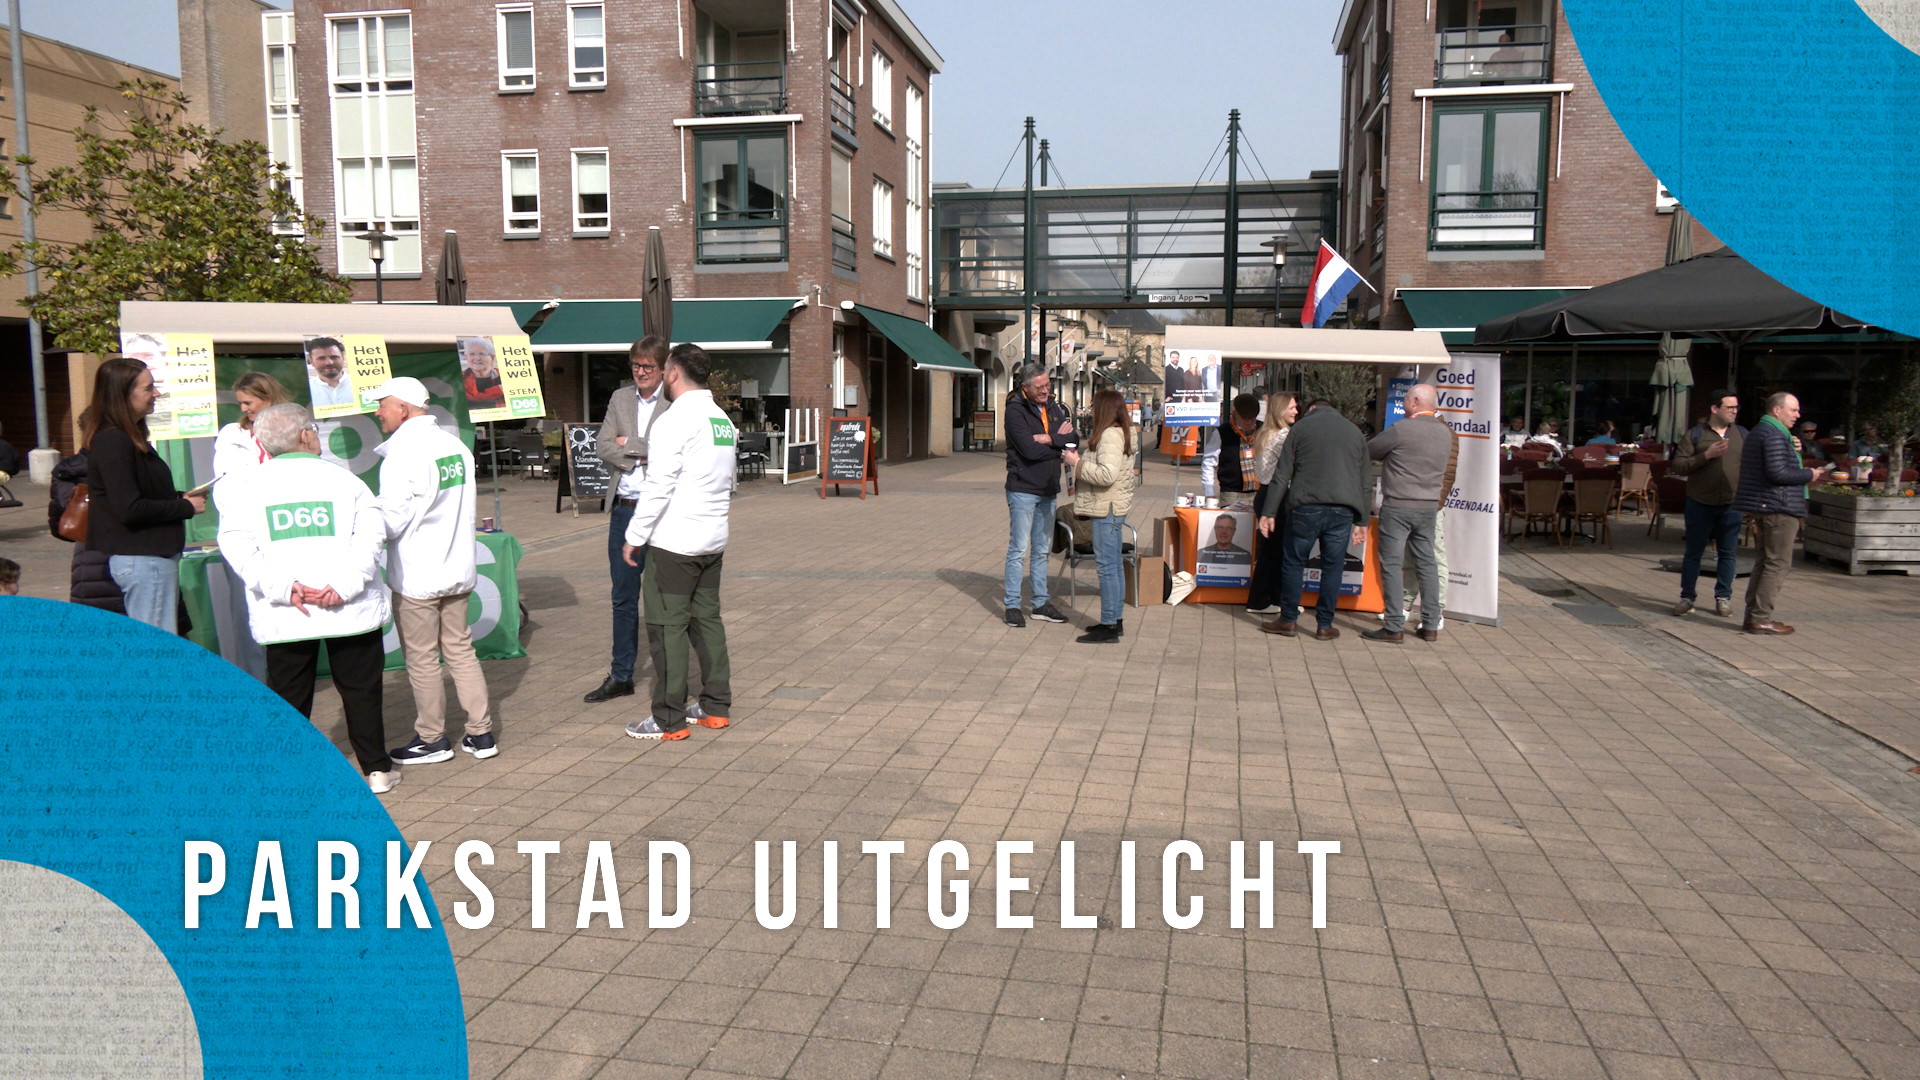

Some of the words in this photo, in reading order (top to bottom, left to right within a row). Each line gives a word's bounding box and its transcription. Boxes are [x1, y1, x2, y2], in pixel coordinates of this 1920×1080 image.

[1151, 294, 1176, 302] Ingang
[1179, 294, 1194, 302] App
[353, 345, 382, 355] Het
[502, 346, 528, 356] Het
[355, 357, 384, 366] kan
[504, 358, 531, 368] kan
[357, 365, 386, 377] wél
[506, 367, 533, 379] wél
[1436, 368, 1476, 385] Goed
[509, 387, 537, 396] STEM
[512, 398, 538, 410] D66
[1437, 392, 1474, 409] Voor
[713, 423, 733, 440] D66
[1444, 419, 1491, 434] endaal
[440, 461, 465, 482] D66
[1448, 488, 1460, 497] NS
[271, 507, 330, 531] D66
